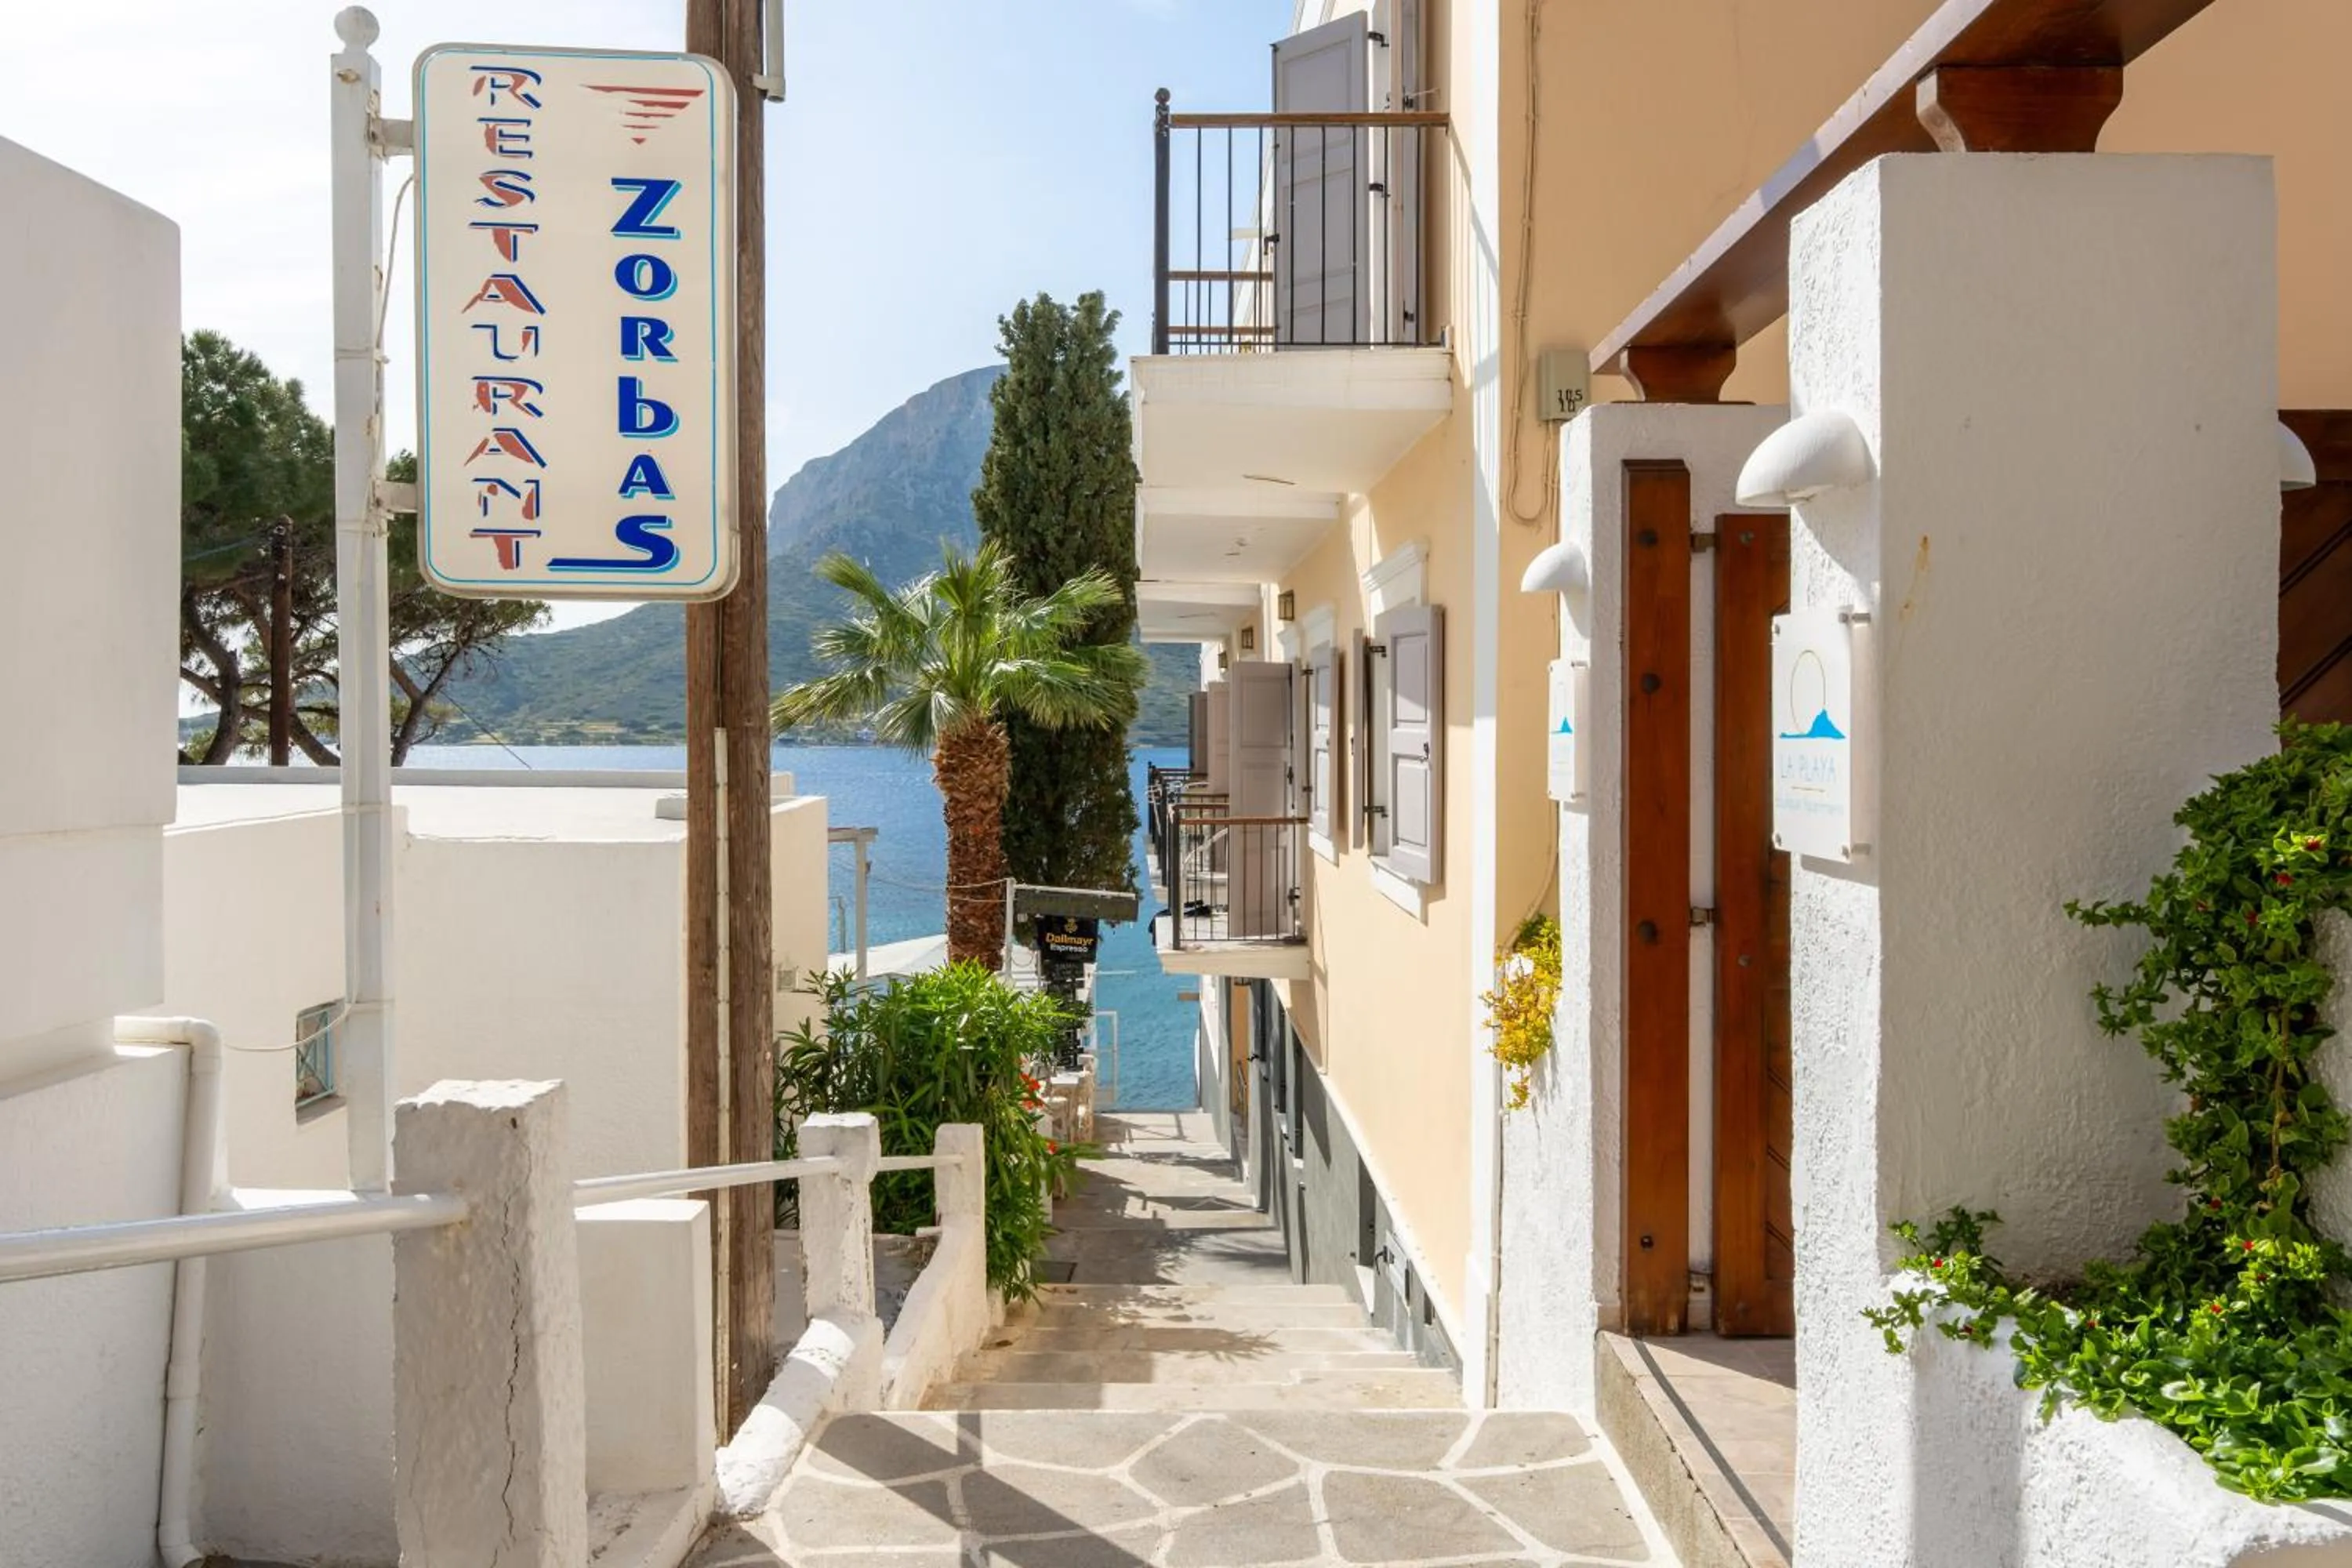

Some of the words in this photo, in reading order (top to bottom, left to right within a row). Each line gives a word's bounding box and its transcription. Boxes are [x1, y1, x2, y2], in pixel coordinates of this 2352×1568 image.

[461, 65, 547, 570] RESTAURANT
[1798, 753, 1837, 783] PLAYA
[1045, 933, 1094, 945] Dallmayr
